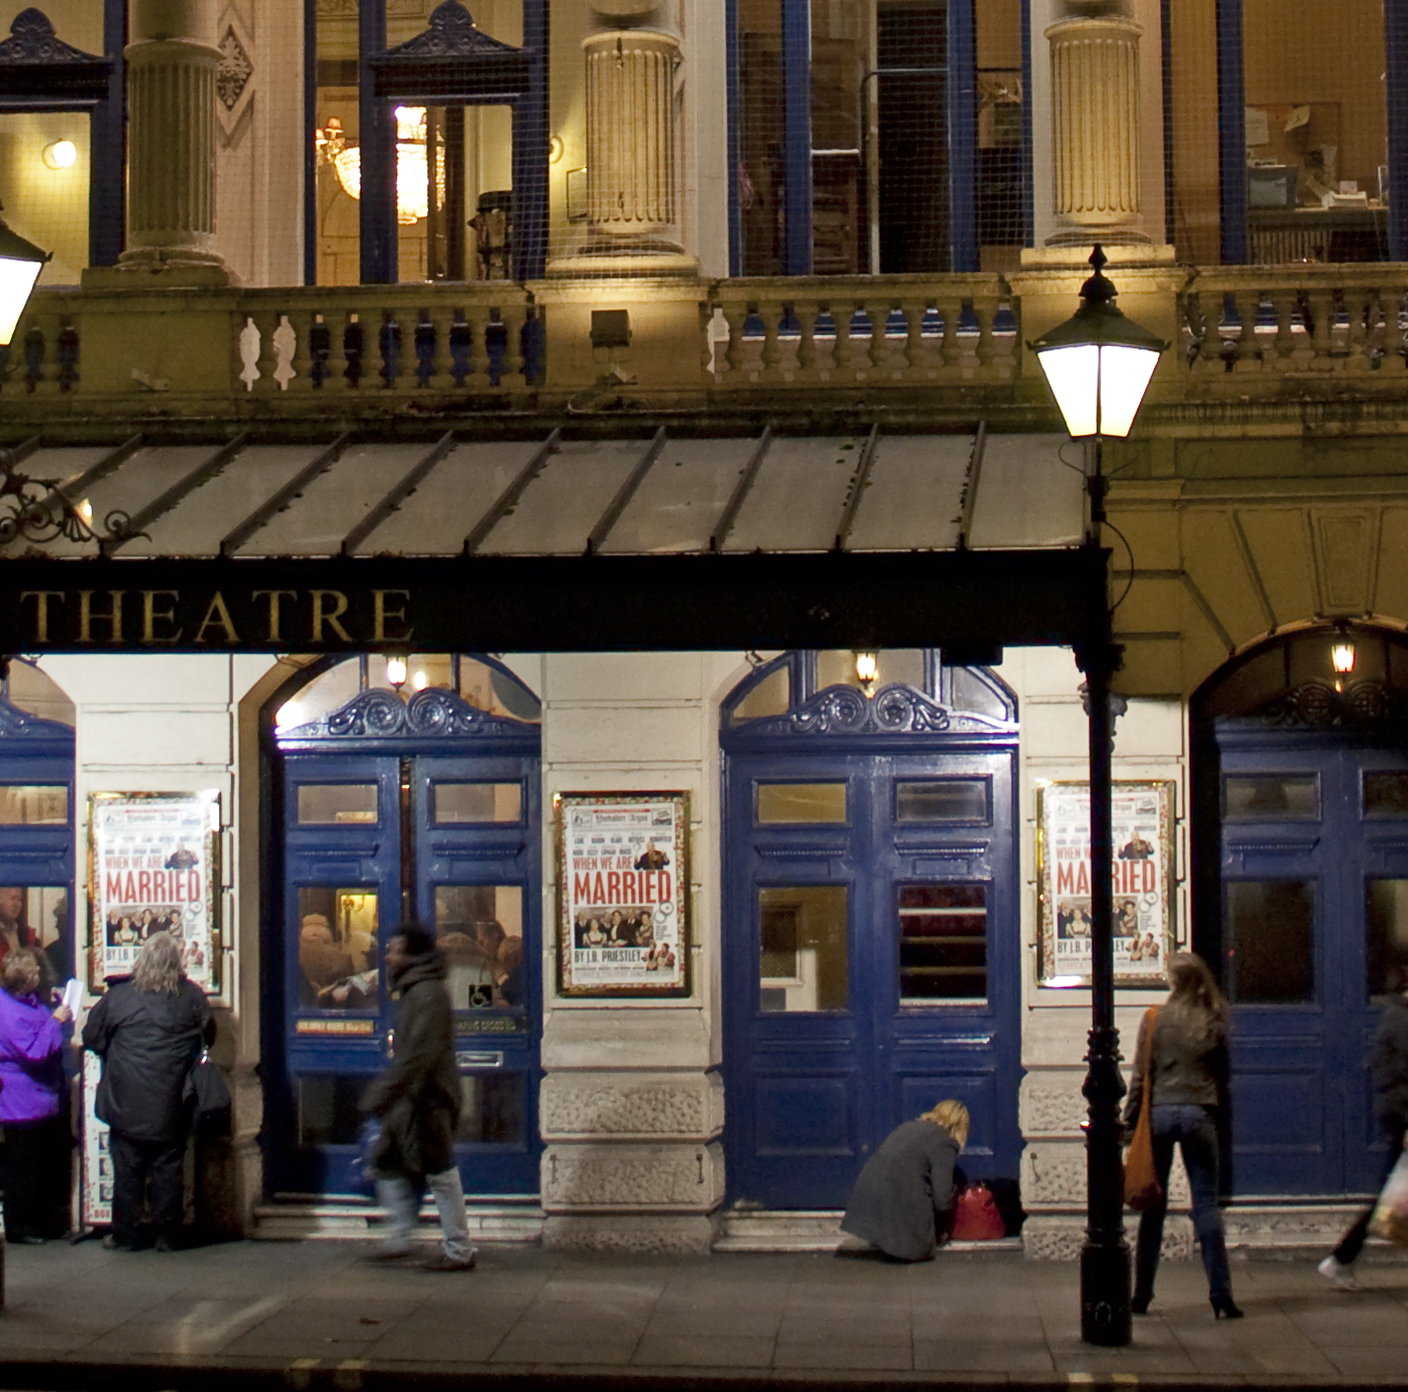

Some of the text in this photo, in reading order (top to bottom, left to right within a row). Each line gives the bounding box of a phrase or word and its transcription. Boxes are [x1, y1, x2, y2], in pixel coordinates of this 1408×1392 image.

[18, 586, 416, 645] THEATRE
[1055, 846, 1081, 860] WHEN
[105, 857, 129, 869] WHEN
[147, 856, 163, 868] ARE
[573, 856, 633, 870] WHEN WE ARE
[1057, 860, 1156, 895] MARIED
[106, 870, 201, 903] MARRIED
[574, 870, 672, 905] MARRIED
[1057, 940, 1068, 953] BY
[574, 950, 585, 963] BY
[601, 949, 642, 963] PRIESTLEY
